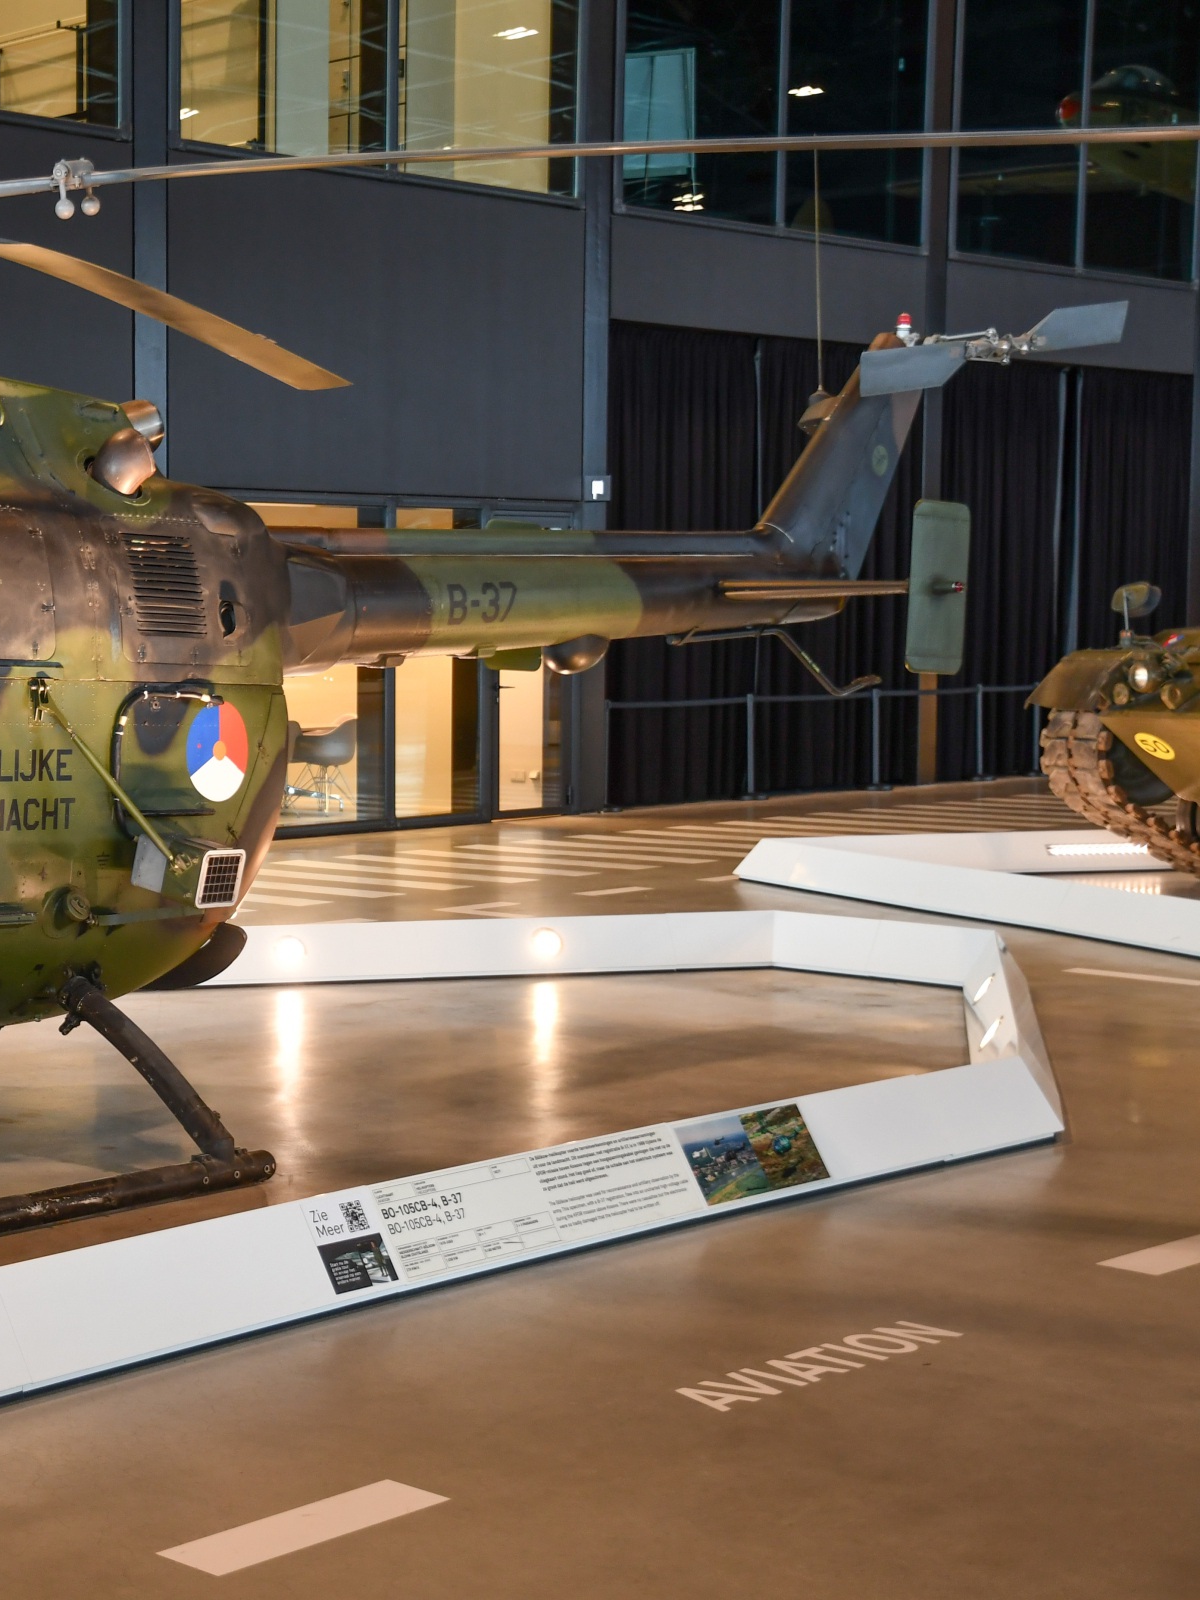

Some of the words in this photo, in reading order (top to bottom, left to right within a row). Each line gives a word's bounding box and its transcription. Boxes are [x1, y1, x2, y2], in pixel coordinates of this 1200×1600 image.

[447, 582, 517, 625] B-37
[1140, 739, 1170, 753] 50
[309, 1210, 328, 1223] Zie
[381, 1198, 441, 1219] BO-105CB-4,
[440, 1192, 462, 1206] B-37
[316, 1224, 344, 1238] Meer
[388, 1213, 446, 1235] BO-105CB-4,
[445, 1208, 465, 1222] B-37
[675, 1320, 964, 1412] AVIATION
